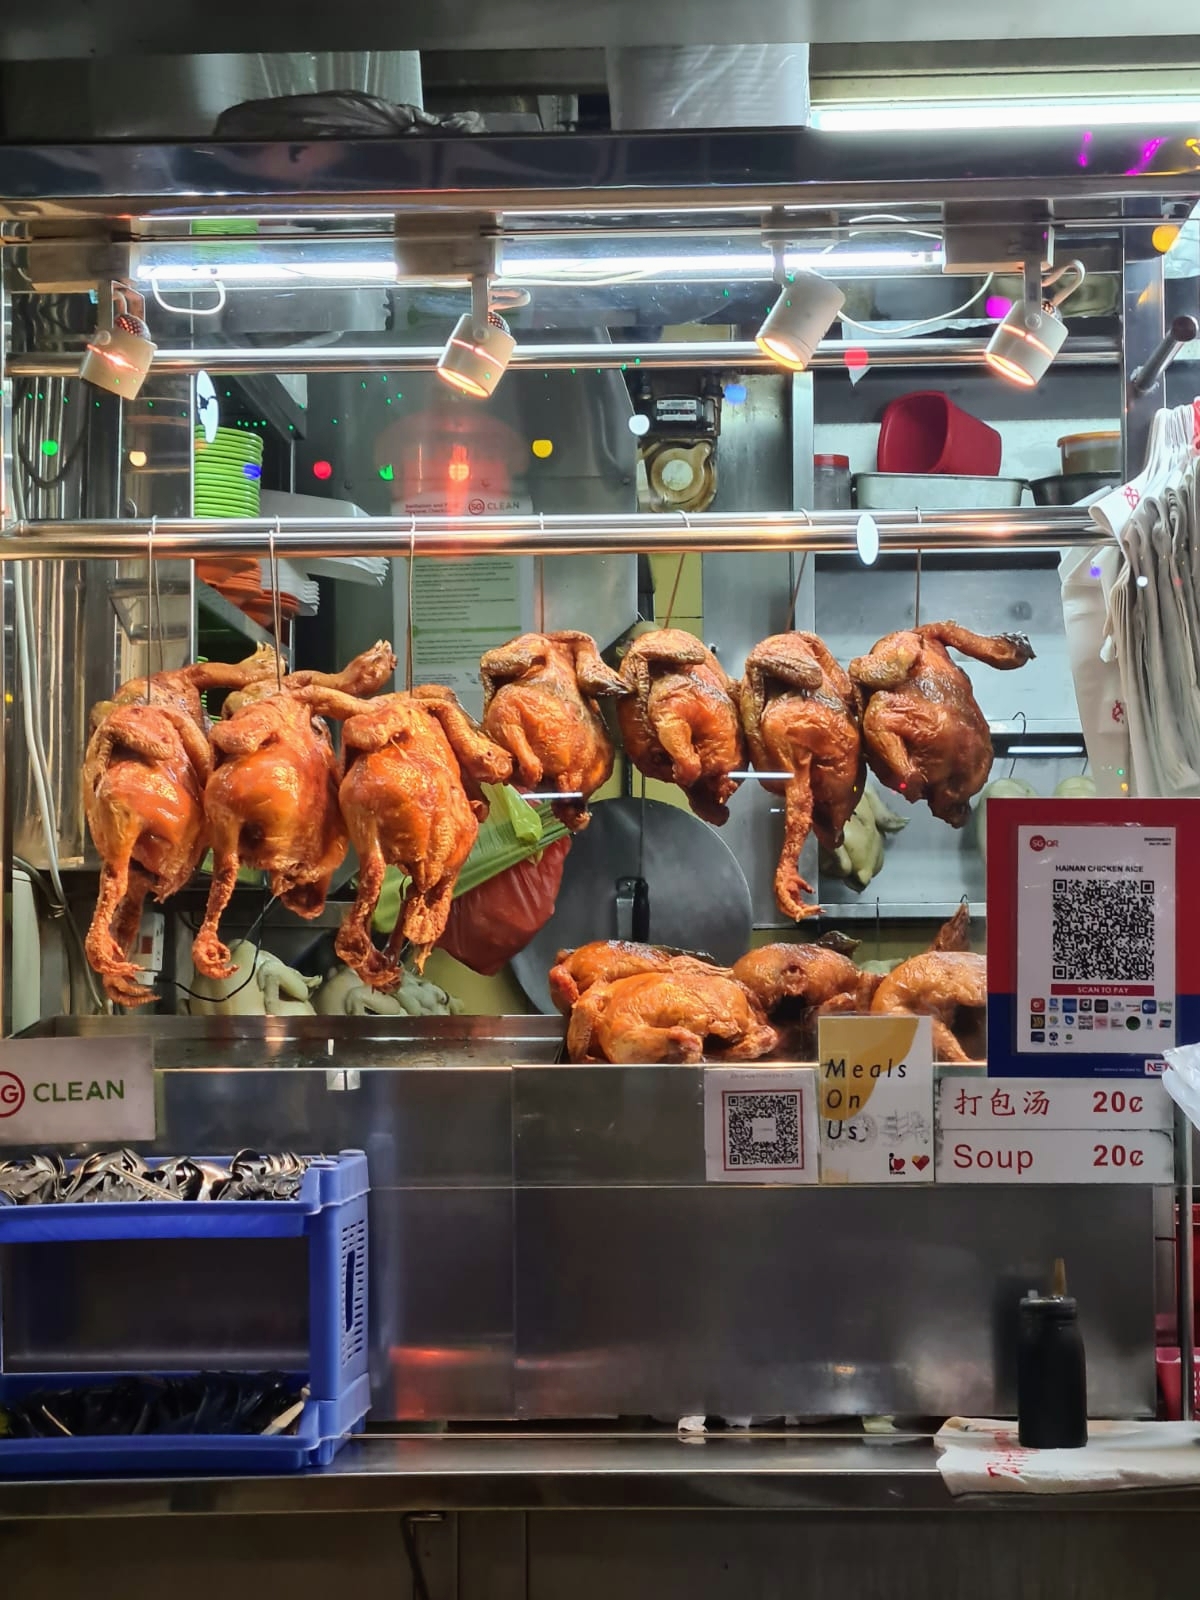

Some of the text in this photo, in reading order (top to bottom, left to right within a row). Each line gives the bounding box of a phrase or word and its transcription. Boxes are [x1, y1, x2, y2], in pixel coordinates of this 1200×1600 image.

[487, 501, 520, 510] CLEAN
[1077, 986, 1129, 994] SCAN TO PAY
[825, 1058, 907, 1078] Meals
[33, 1079, 125, 1103] CLEAN
[826, 1089, 860, 1109] On
[953, 1088, 1050, 1117] 打包汤
[1093, 1091, 1144, 1113] 20¢
[827, 1120, 857, 1140] Us
[953, 1143, 1144, 1174] Soup 20¢
